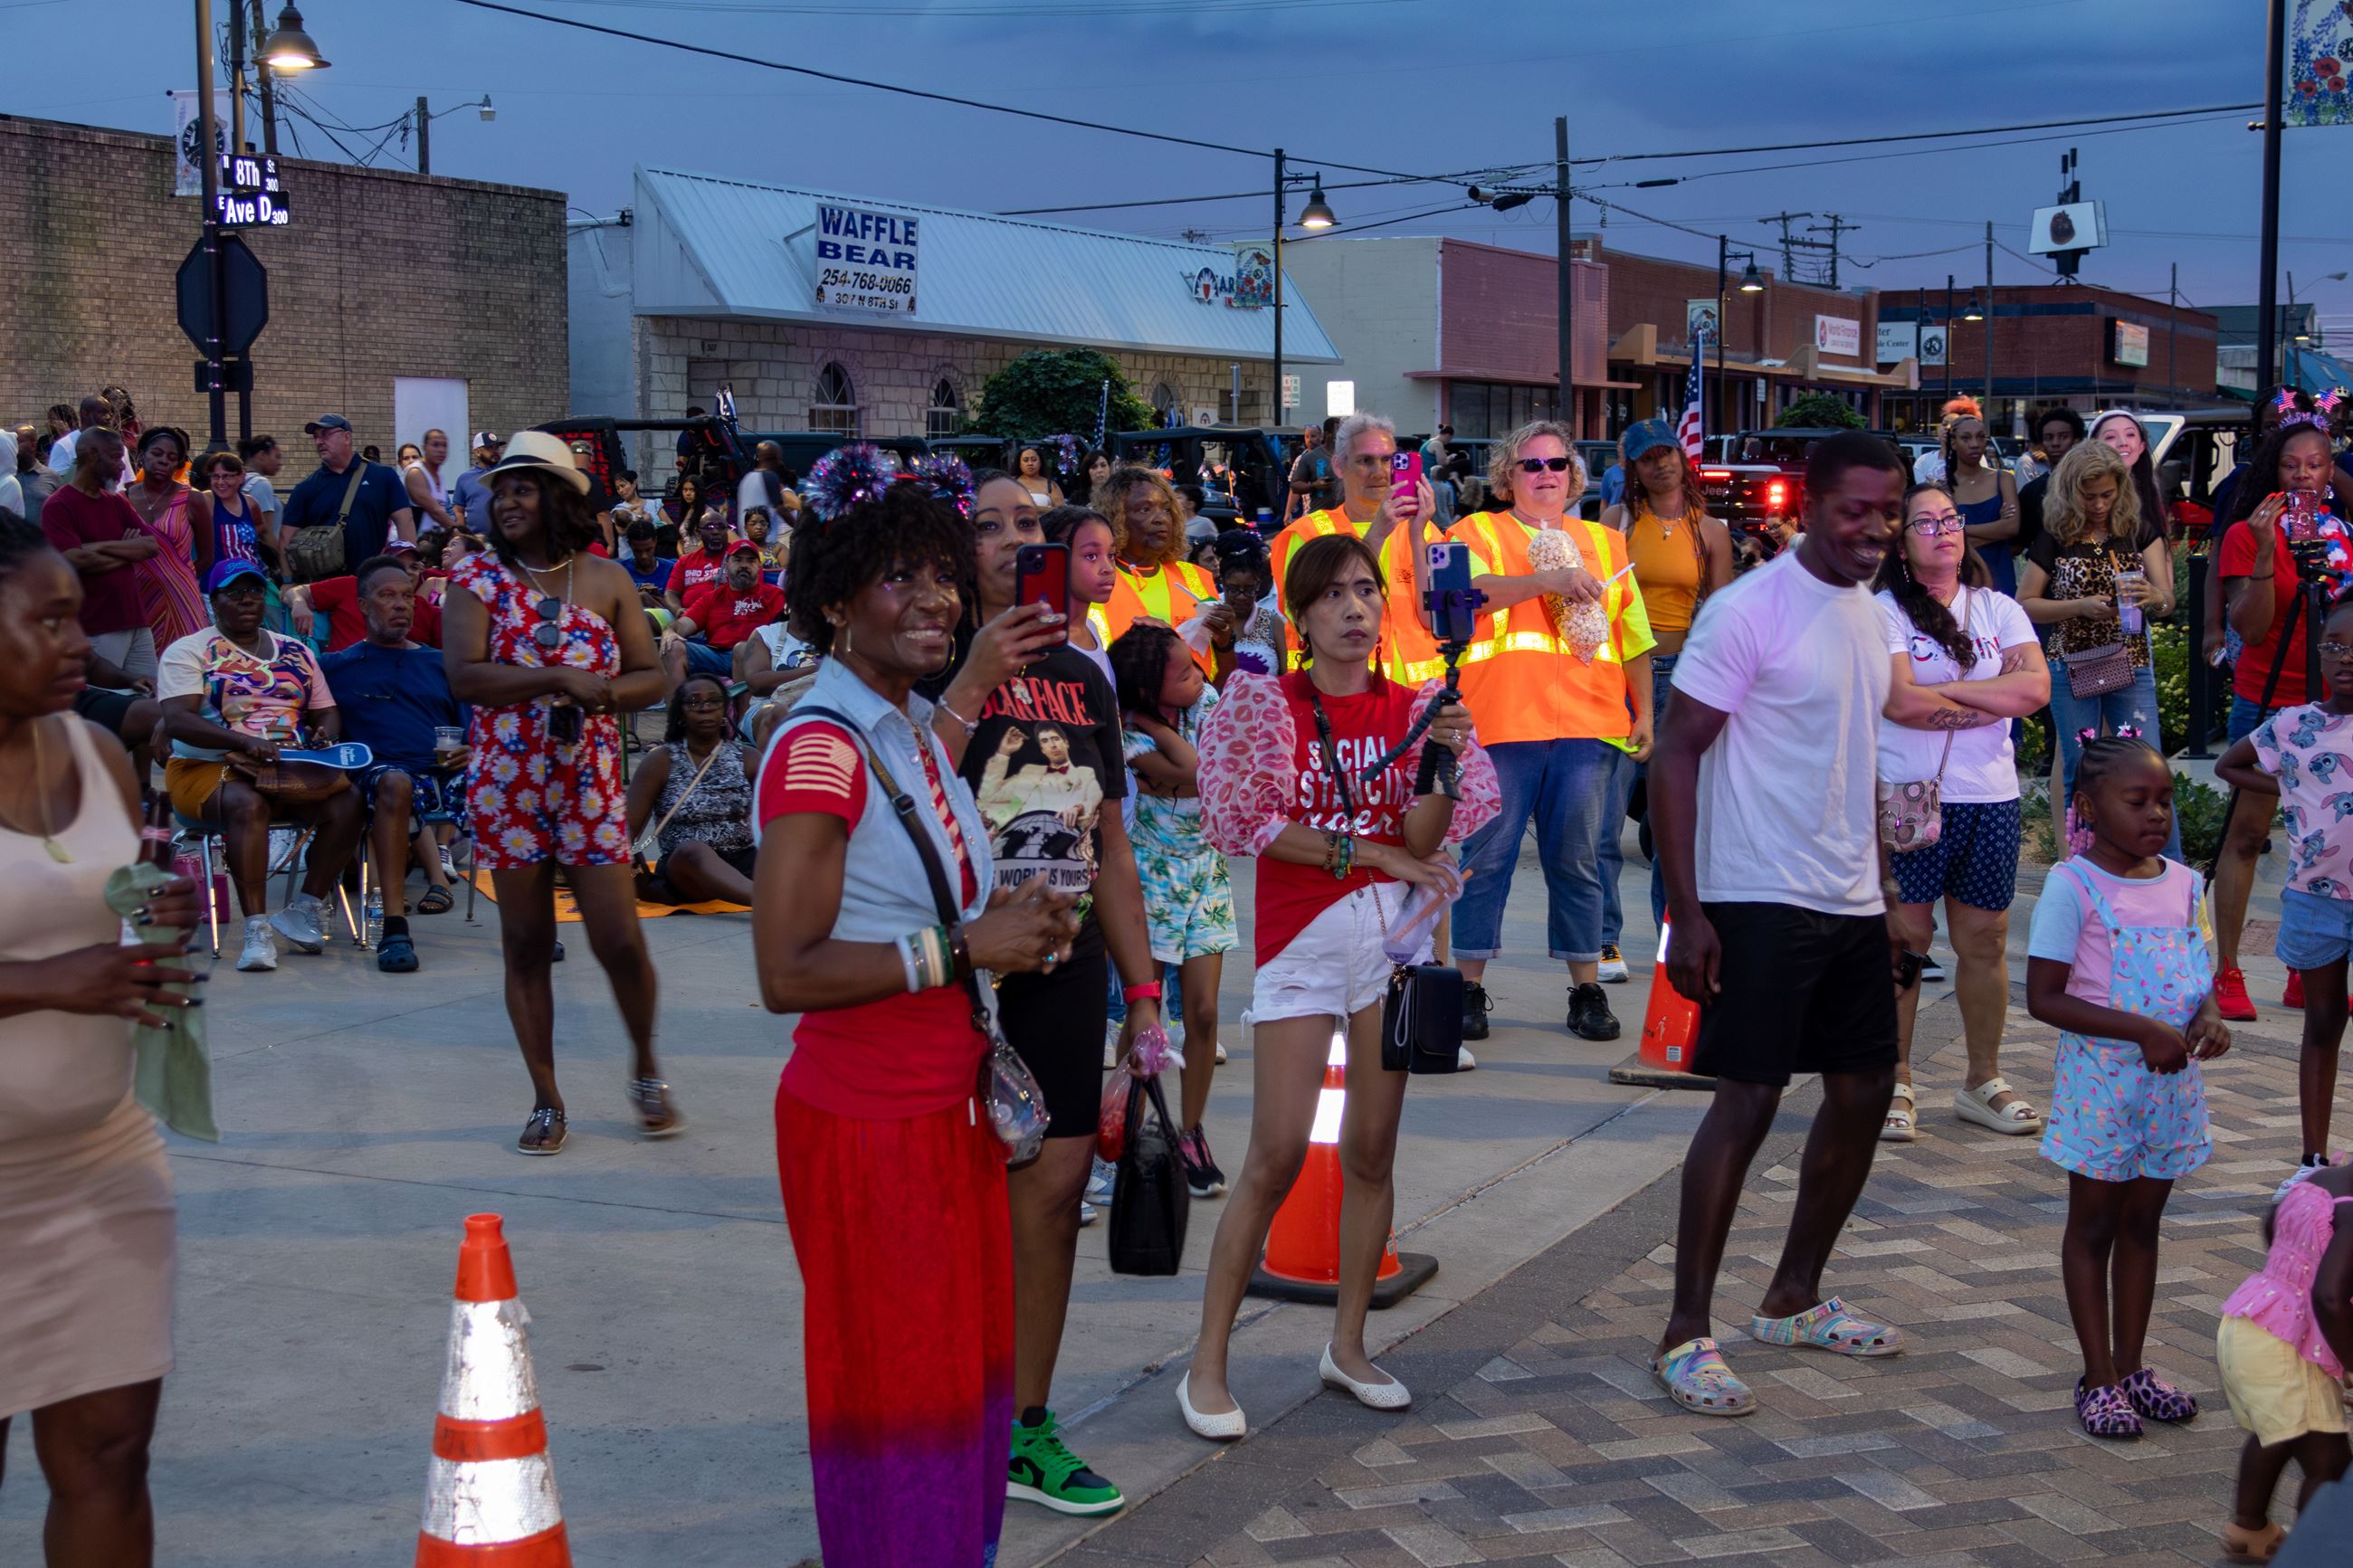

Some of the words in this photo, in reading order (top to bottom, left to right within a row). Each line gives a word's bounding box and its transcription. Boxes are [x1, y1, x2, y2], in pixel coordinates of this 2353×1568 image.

[235, 159, 260, 186] 8Th
[267, 159, 275, 173] St
[265, 178, 279, 192] 300
[218, 196, 224, 210] E
[225, 196, 254, 223] Ave
[259, 196, 272, 222] D
[272, 210, 288, 224] 300
[821, 207, 917, 246] WAFFLE
[818, 240, 915, 271] BEAR
[858, 294, 865, 306] N
[868, 296, 886, 309] 8TH
[1886, 339, 1910, 347] Center
[1703, 485, 1729, 498] Jeep
[684, 569, 702, 578] OHIO
[1308, 736, 1395, 773] SCIAL
[1300, 767, 1405, 809] STANCIN
[1000, 867, 1047, 887] WOR
[1048, 868, 1058, 886] IS
[1061, 868, 1088, 887] YOURS
